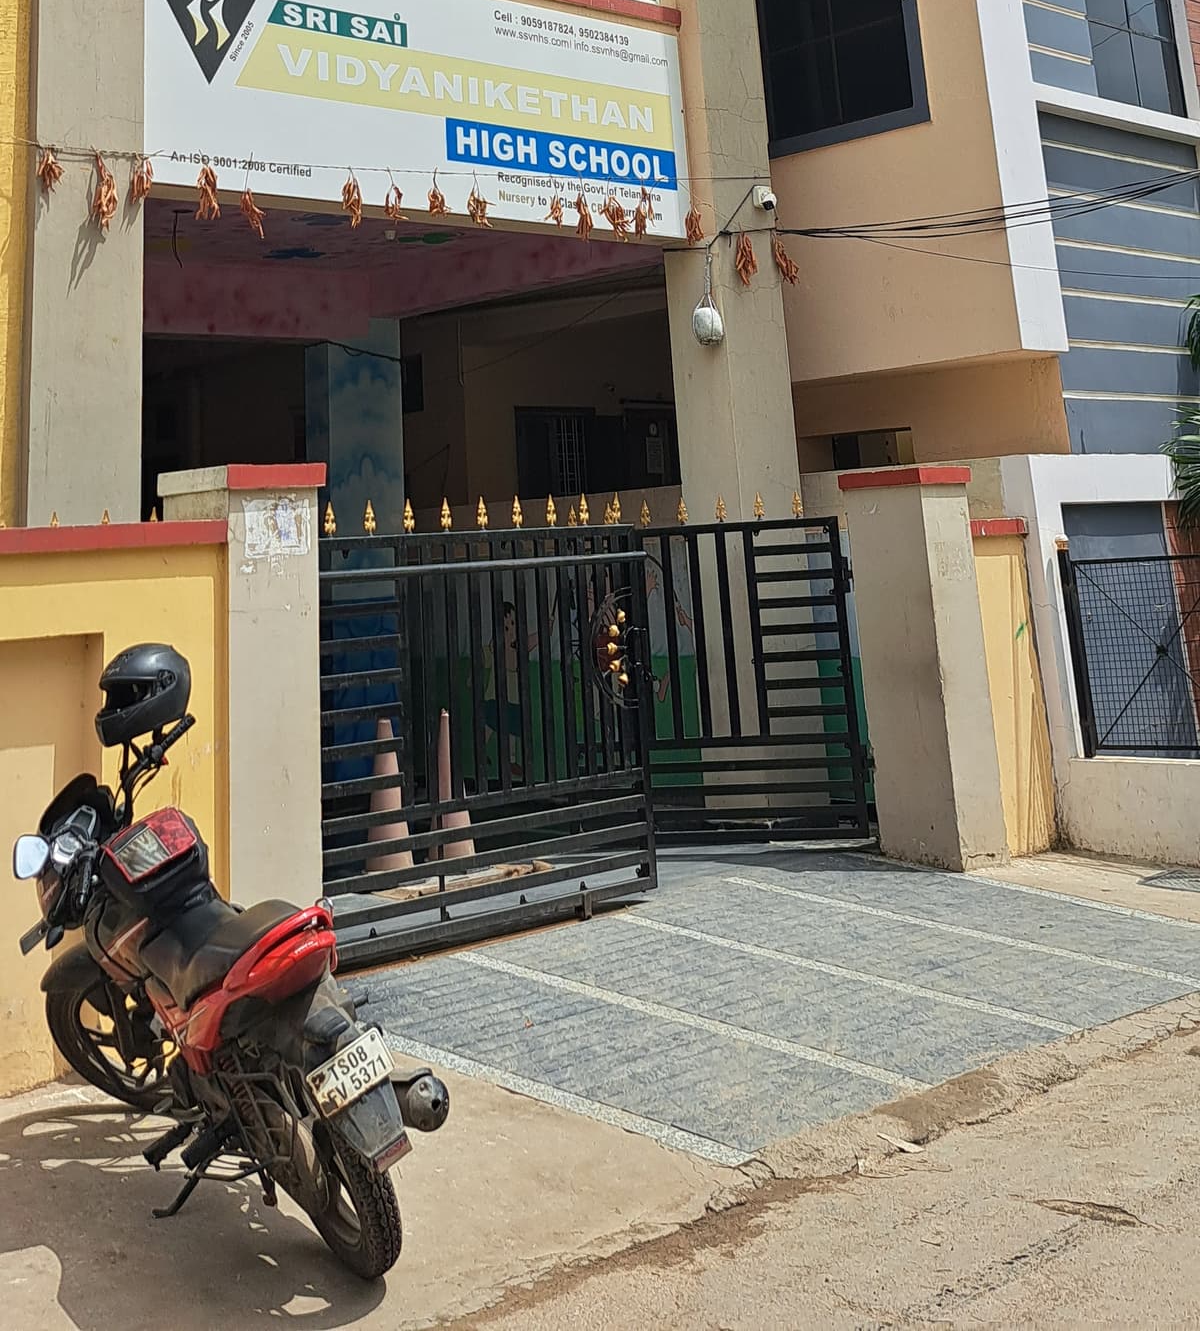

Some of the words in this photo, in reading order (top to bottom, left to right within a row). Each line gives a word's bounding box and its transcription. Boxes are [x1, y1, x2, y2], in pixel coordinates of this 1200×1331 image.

[283, 3, 337, 33] SRI
[494, 10, 512, 23] Cell
[520, 15, 577, 38] 9059187824,
[579, 27, 629, 46] 9502384139
[229, 40, 244, 62] Since
[241, 20, 254, 40] 2005
[574, 39, 668, 67] info.ssvnhs@gmail.com
[277, 44, 654, 133] VIDYANIKETHAN
[170, 151, 186, 162] An
[189, 153, 210, 165] ISO
[213, 156, 266, 172] 9001:2008
[269, 163, 312, 177] Certified
[456, 126, 538, 165] HIGH
[549, 140, 669, 183] SCHOOL
[497, 171, 552, 188] Recognised
[554, 179, 565, 192] by
[567, 180, 581, 191] the
[608, 186, 617, 196] of
[499, 190, 535, 206] Nursery
[538, 195, 547, 206] to
[327, 1045, 368, 1081] TS08
[350, 1054, 387, 1090] 5371
